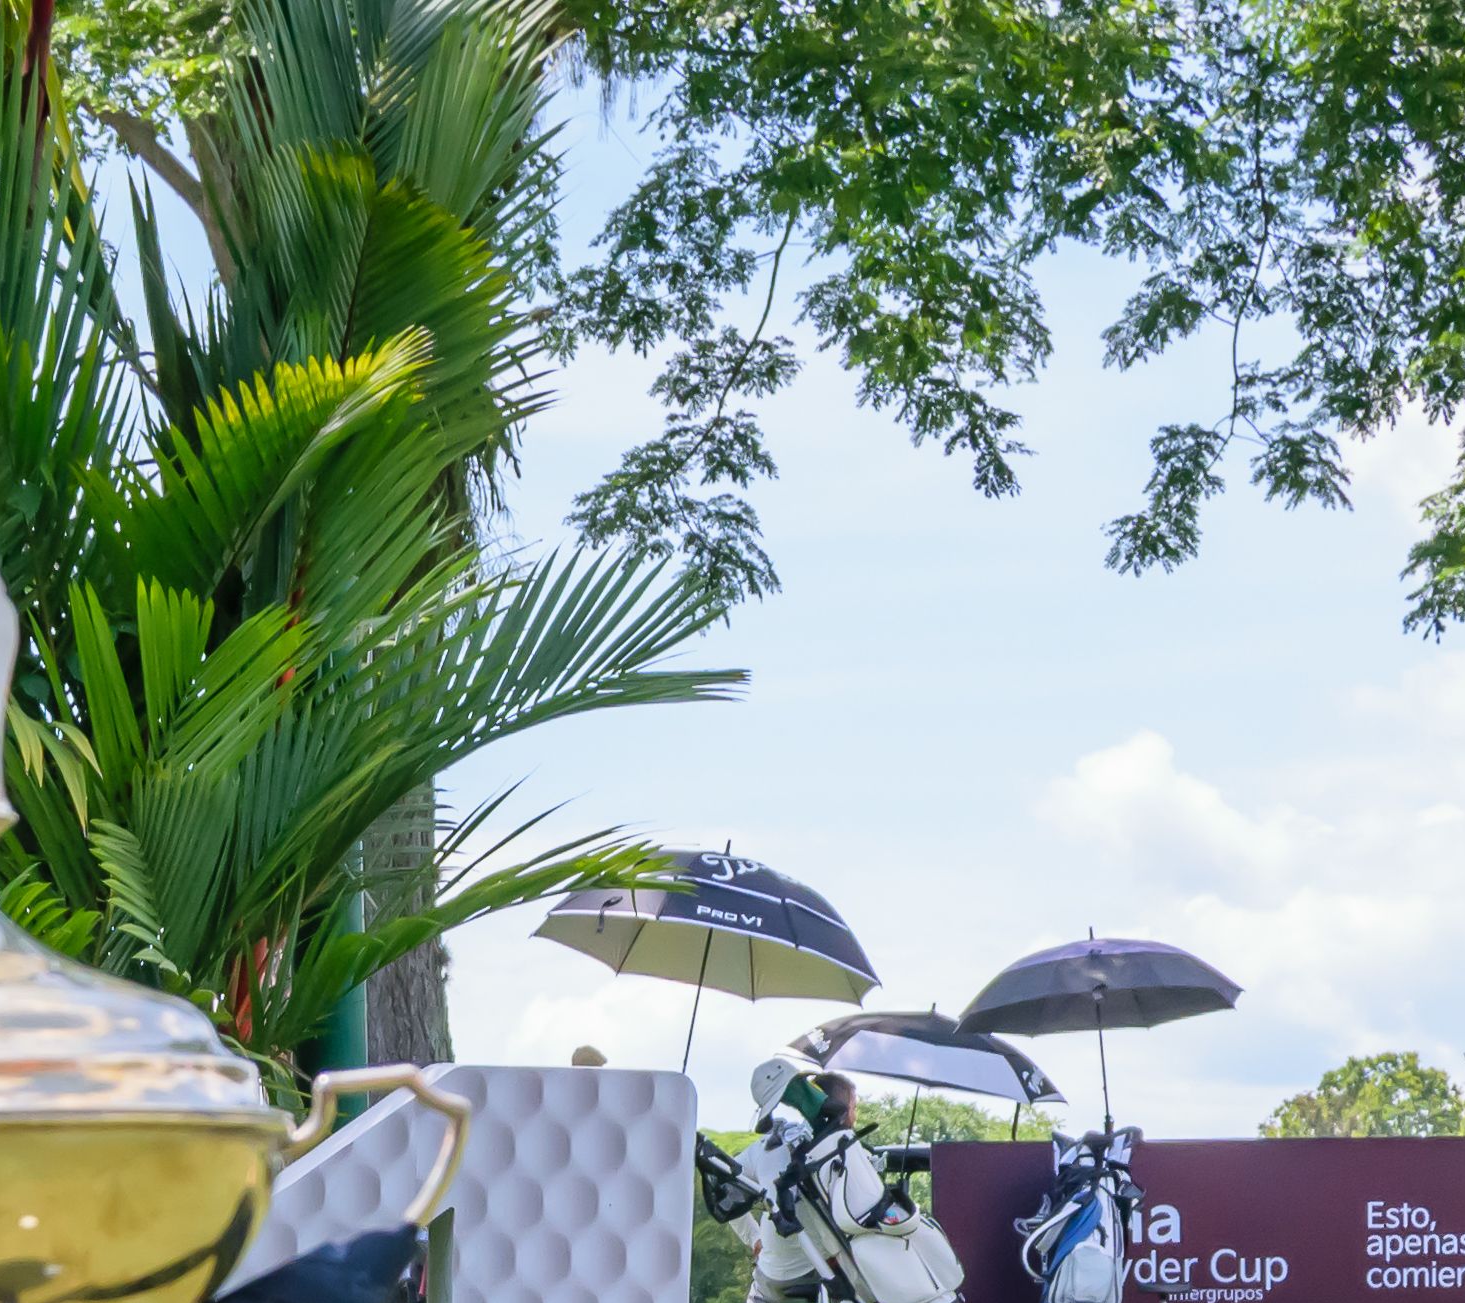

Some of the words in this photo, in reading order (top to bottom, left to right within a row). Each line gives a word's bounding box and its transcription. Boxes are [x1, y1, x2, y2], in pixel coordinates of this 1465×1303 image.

[1130, 1204, 1181, 1244] ia
[1367, 1201, 1437, 1231] Esto,
[1210, 1248, 1289, 1291] Cup
